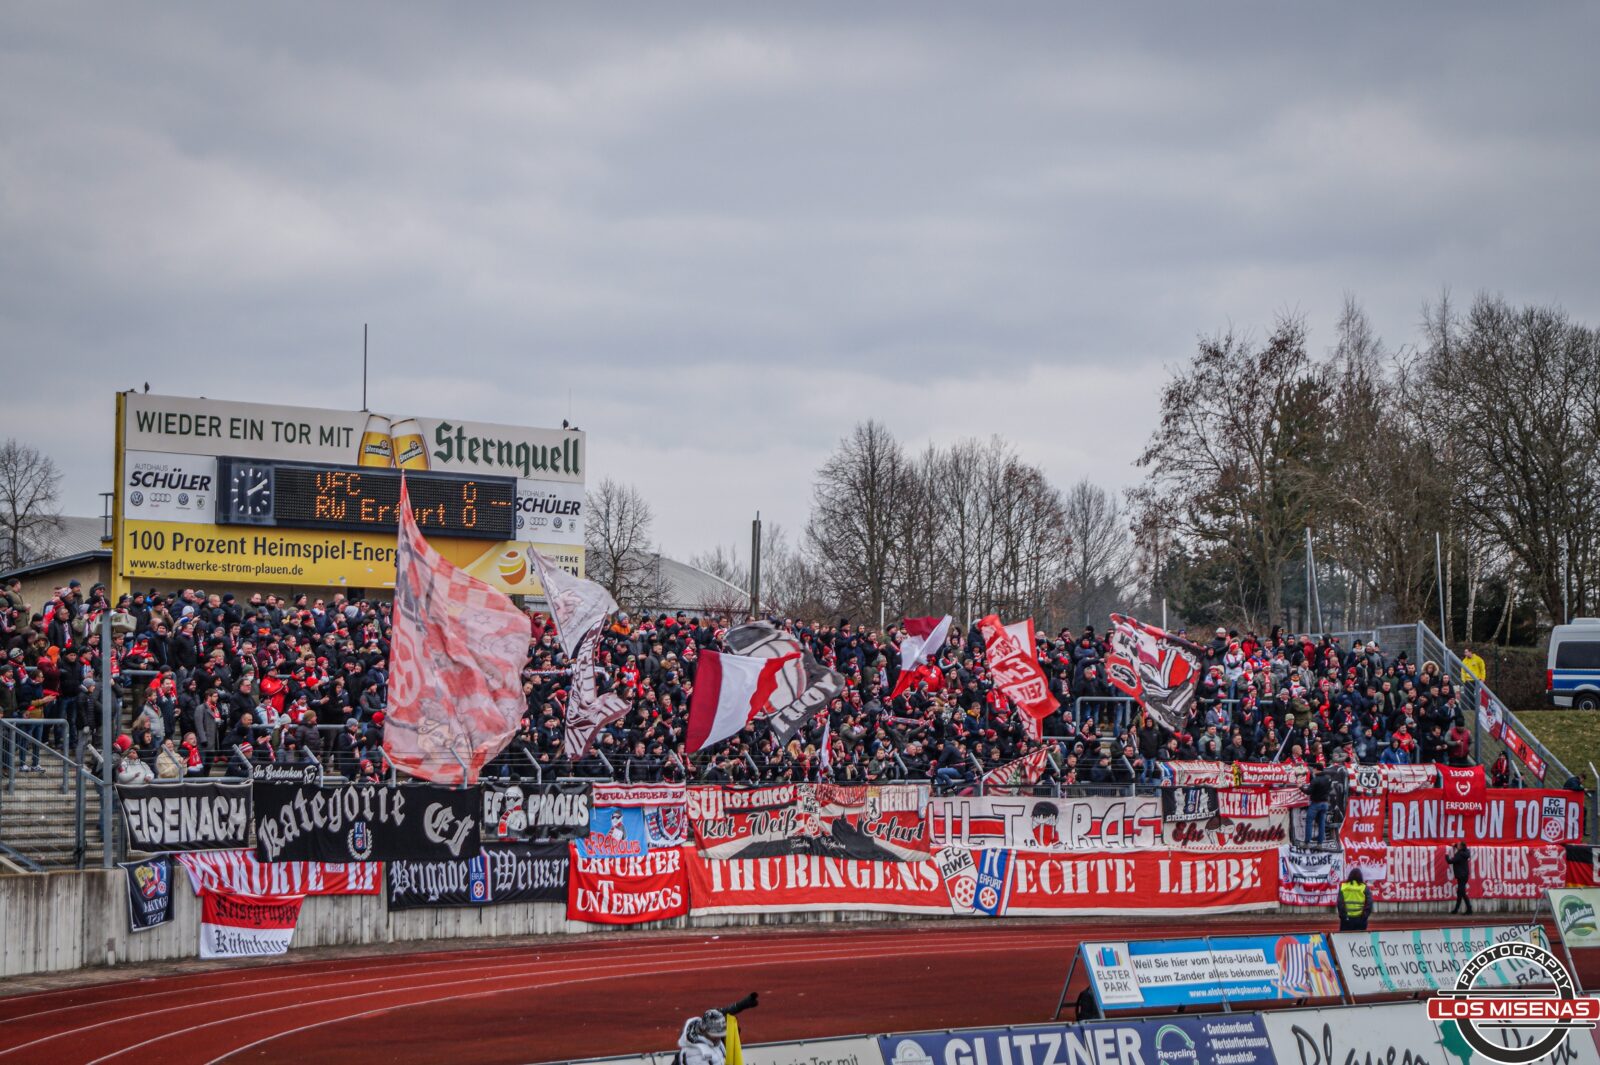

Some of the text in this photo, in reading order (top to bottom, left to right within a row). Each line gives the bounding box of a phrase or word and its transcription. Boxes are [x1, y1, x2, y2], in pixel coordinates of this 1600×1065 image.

[136, 410, 354, 448] WIEDER EIN TOR MIT
[433, 420, 581, 477] Sternquell
[129, 468, 211, 491] SCHÜLER
[315, 471, 361, 496] VFC
[314, 495, 346, 519] RW
[129, 529, 399, 568] 100 Prozent Heimspiel-Energ
[129, 559, 304, 576] www.stadtwerke-strom-plauen.de
[1184, 774, 1220, 785] Land
[1243, 771, 1289, 782] Supporters
[1360, 772, 1378, 787] 66
[1450, 769, 1474, 777] LEGIO
[724, 791, 749, 808] LOS
[752, 785, 794, 806] CHICOS
[1548, 798, 1561, 807] FC
[484, 791, 589, 826] EF PAROLIS
[1349, 799, 1381, 817] RWE
[1544, 806, 1565, 816] RWE
[126, 797, 248, 843] EISENACH
[257, 784, 406, 862] Kategorie
[699, 816, 736, 838] Rot
[746, 810, 798, 837] Weiß
[863, 816, 925, 842] Erfurt
[1391, 799, 1466, 841] DANIEL
[1232, 822, 1286, 845] Youth
[1344, 837, 1388, 852] Apolda
[942, 853, 971, 877] RWE
[1387, 846, 1530, 882] ERFURT SPORTERS
[390, 849, 569, 902] Brigade Weimar
[979, 874, 1003, 889] ERFURT
[1015, 860, 1136, 895] ECHTE
[1158, 857, 1263, 893] LIEBE
[576, 880, 682, 915] UNTERWEGS
[1482, 880, 1536, 897] Löwen
[215, 896, 298, 925] Reisegruppe
[1349, 941, 1377, 958] Kein
[1379, 940, 1399, 956] Tor
[1403, 937, 1432, 953] mehr
[1133, 952, 1264, 969] Weil Sie hier vom Adria-Urlaub
[1352, 963, 1384, 980] Sport
[1386, 964, 1400, 976] im
[1403, 959, 1460, 974] VOGTLAND
[1097, 970, 1131, 980] ELSTER
[1139, 966, 1279, 983] bis zum Zander alles bekommen.
[1104, 981, 1131, 992] PARK
[1206, 1022, 1255, 1035] Containerdienst
[944, 1028, 1142, 1065] GLITZNER
[1211, 1037, 1269, 1050] Wertstofferfassung
[1158, 1049, 1197, 1060] Recycling
[1215, 1052, 1257, 1064] Sonderabfall-
